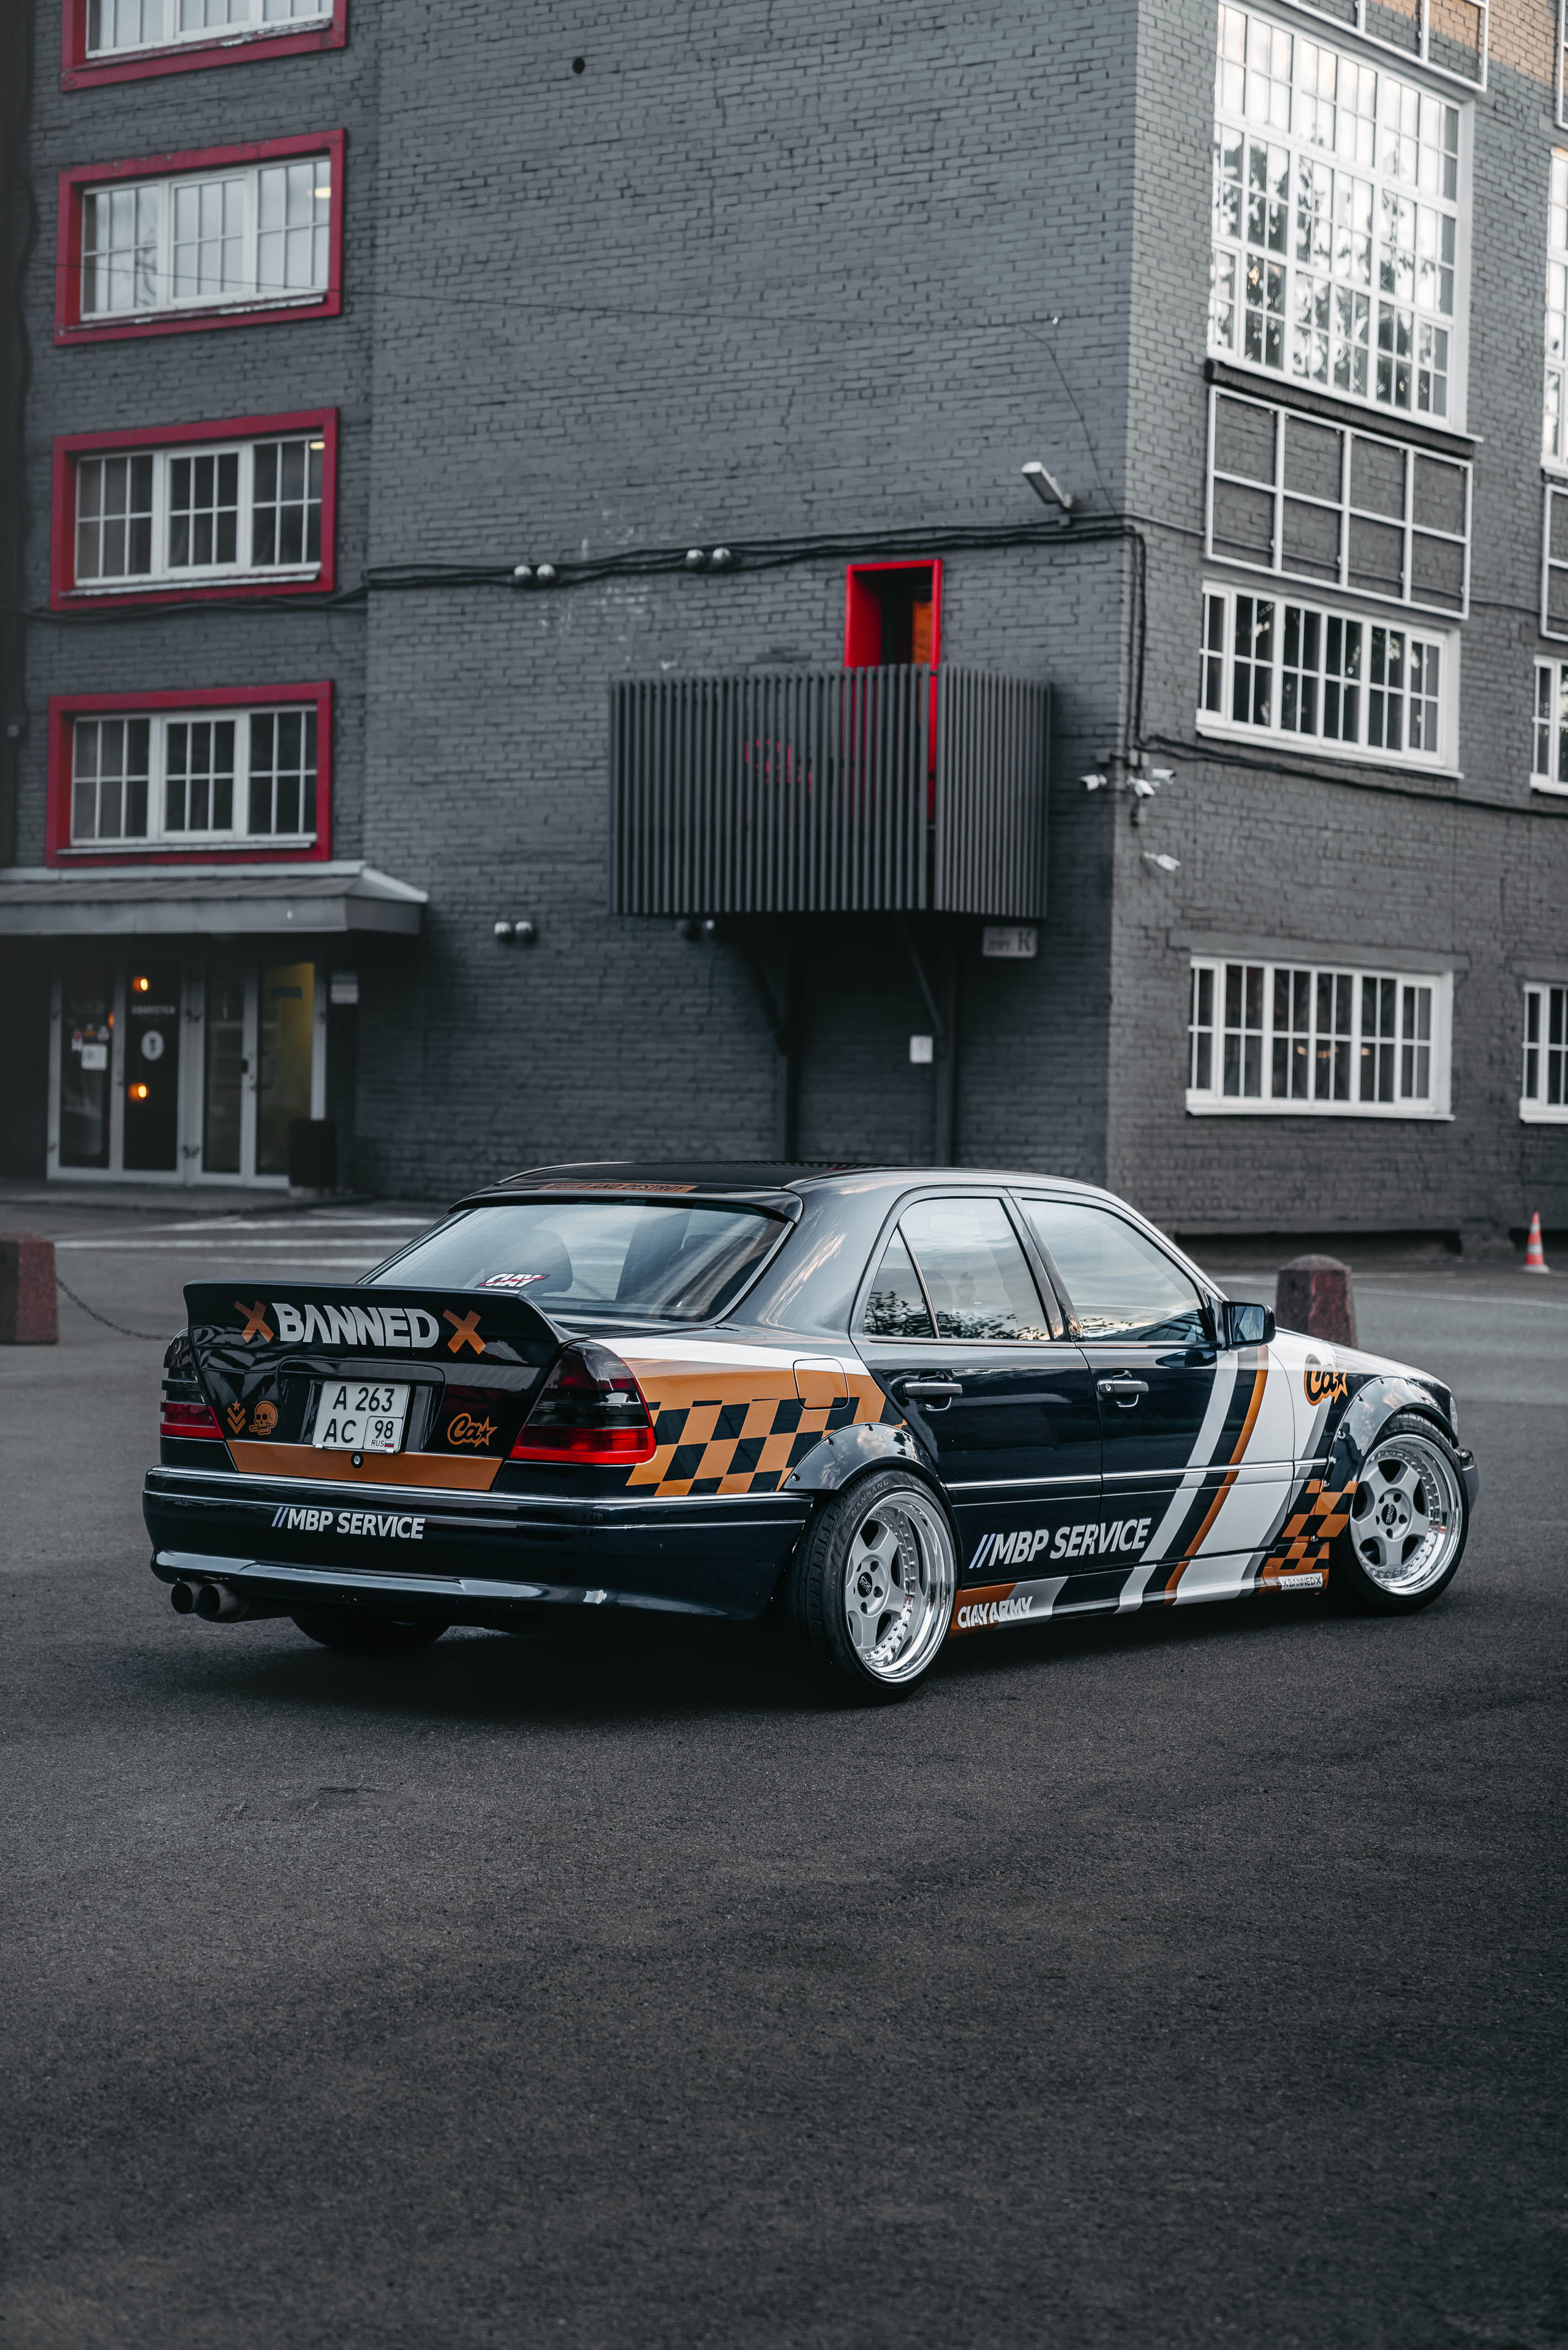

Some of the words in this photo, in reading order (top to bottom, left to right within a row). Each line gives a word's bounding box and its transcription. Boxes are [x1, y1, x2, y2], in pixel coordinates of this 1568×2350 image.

[272, 1303, 439, 1348] BANNED
[355, 1387, 395, 1412] 263
[323, 1418, 357, 1444] AC
[374, 1420, 394, 1439] 98
[336, 1512, 426, 1540] SERVICE
[1049, 1518, 1152, 1559] SERVICE
